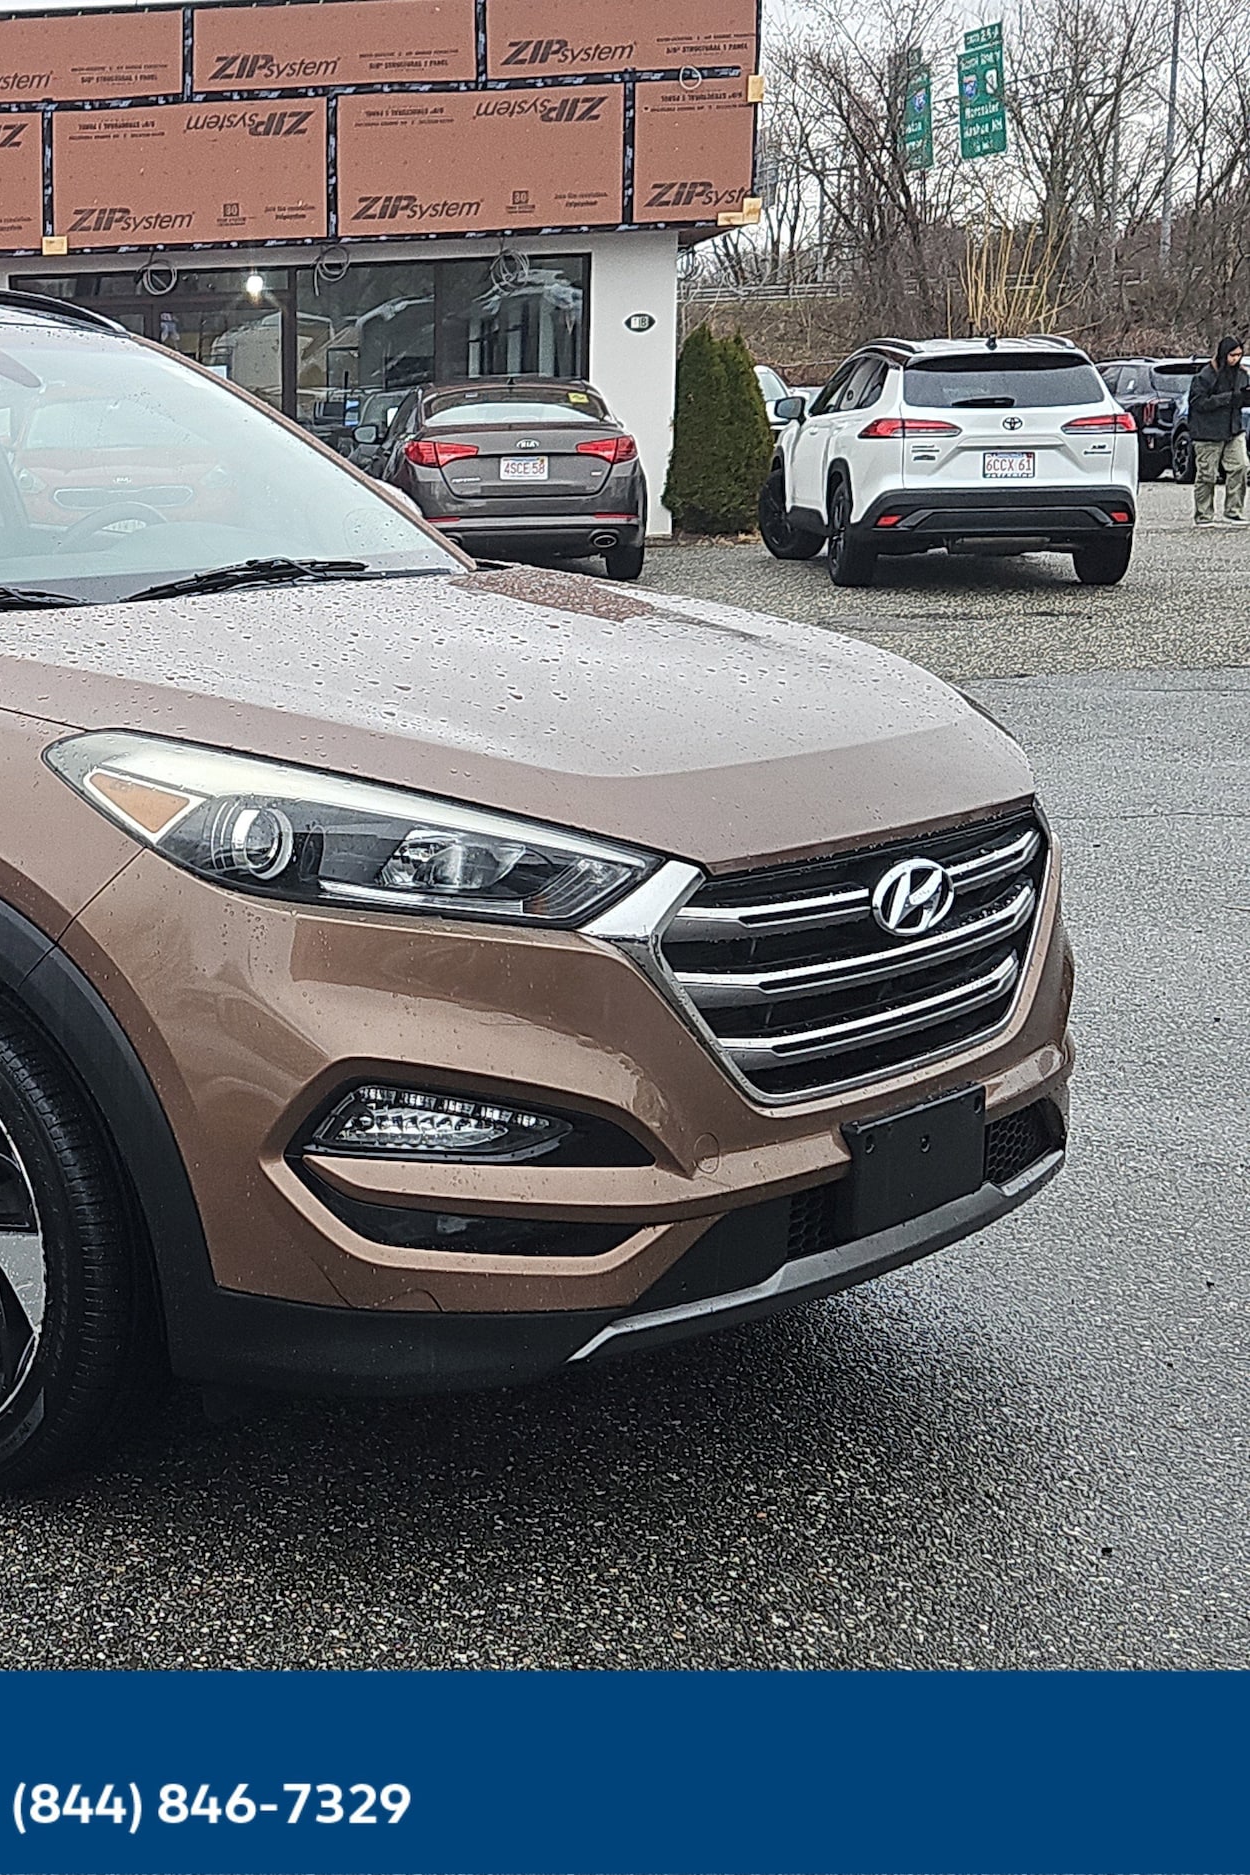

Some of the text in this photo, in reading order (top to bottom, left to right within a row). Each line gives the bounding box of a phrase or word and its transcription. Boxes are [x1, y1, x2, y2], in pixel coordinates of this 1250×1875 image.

[504, 462, 529, 475] 4SCE
[986, 459, 1031, 471] 6CCX 61
